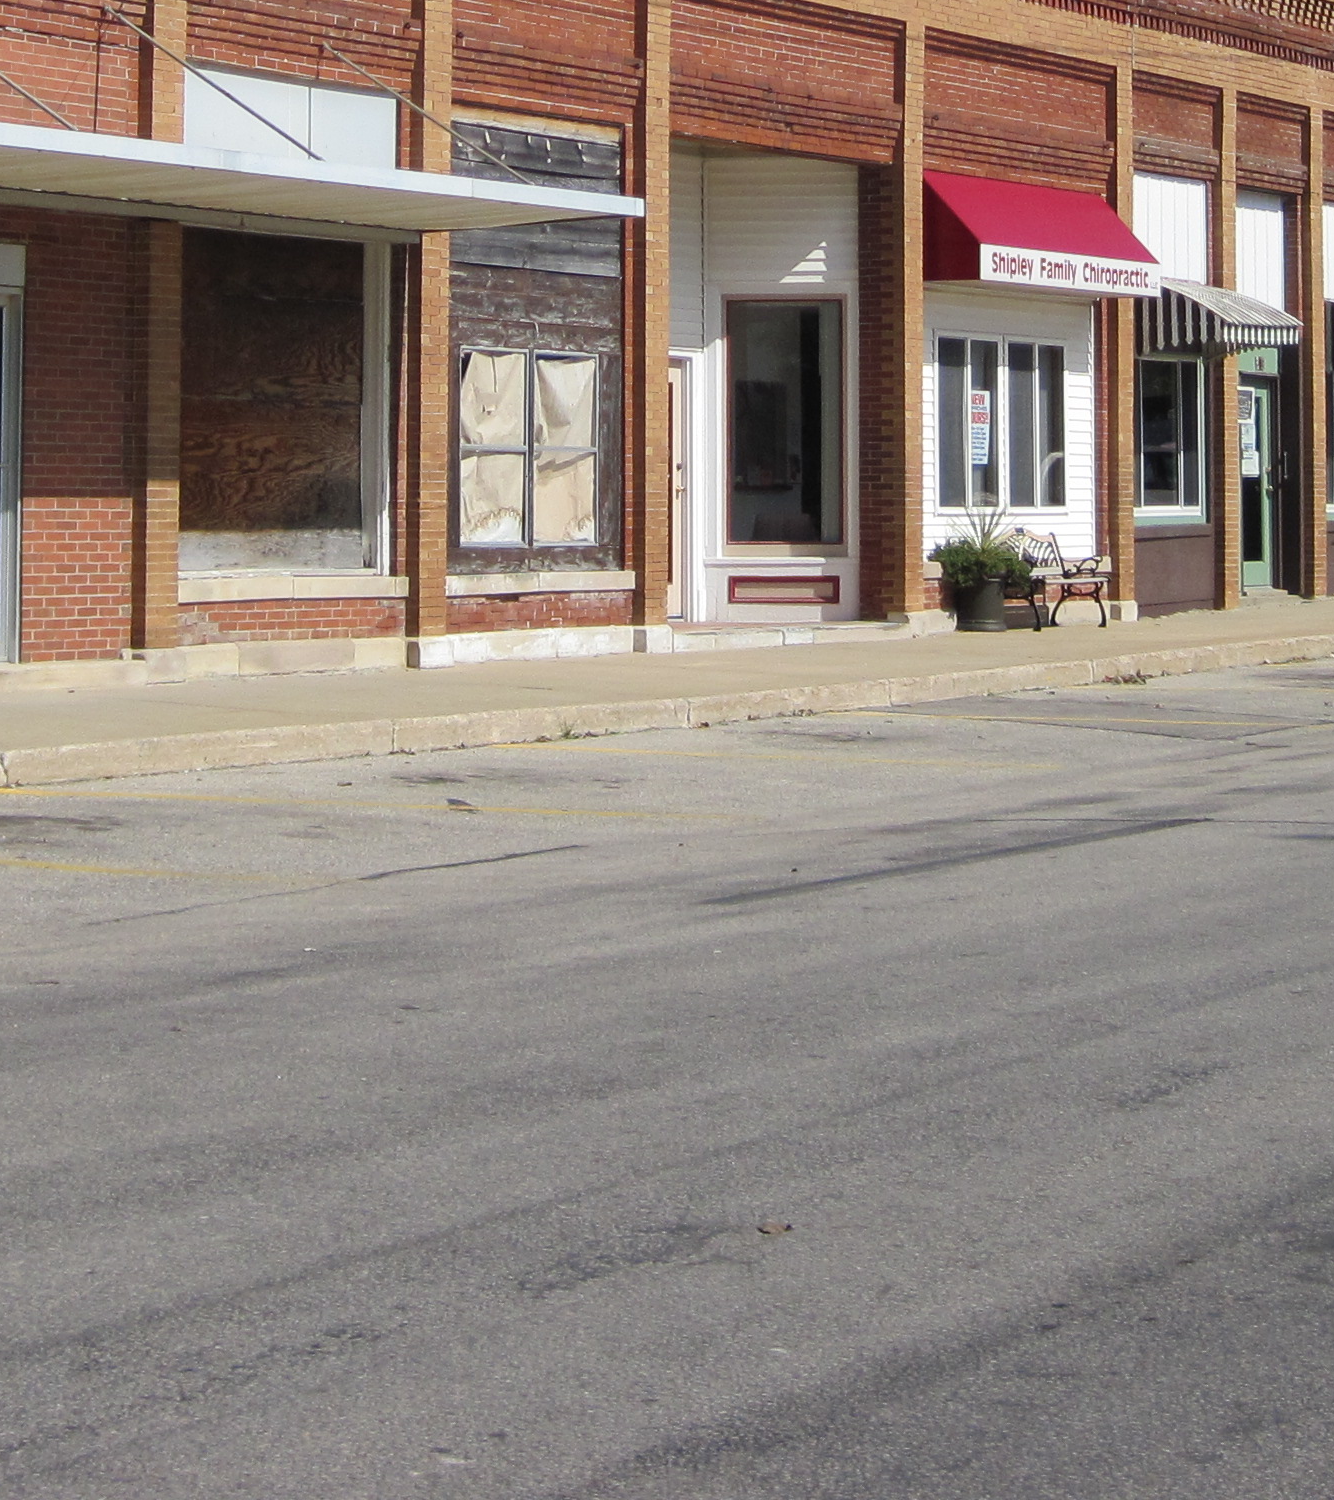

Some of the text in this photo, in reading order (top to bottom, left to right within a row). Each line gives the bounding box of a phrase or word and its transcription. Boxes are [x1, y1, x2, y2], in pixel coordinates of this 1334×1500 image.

[991, 252, 1034, 280] Shipley
[1040, 258, 1078, 285] Family
[1082, 262, 1149, 289] Chiropractic
